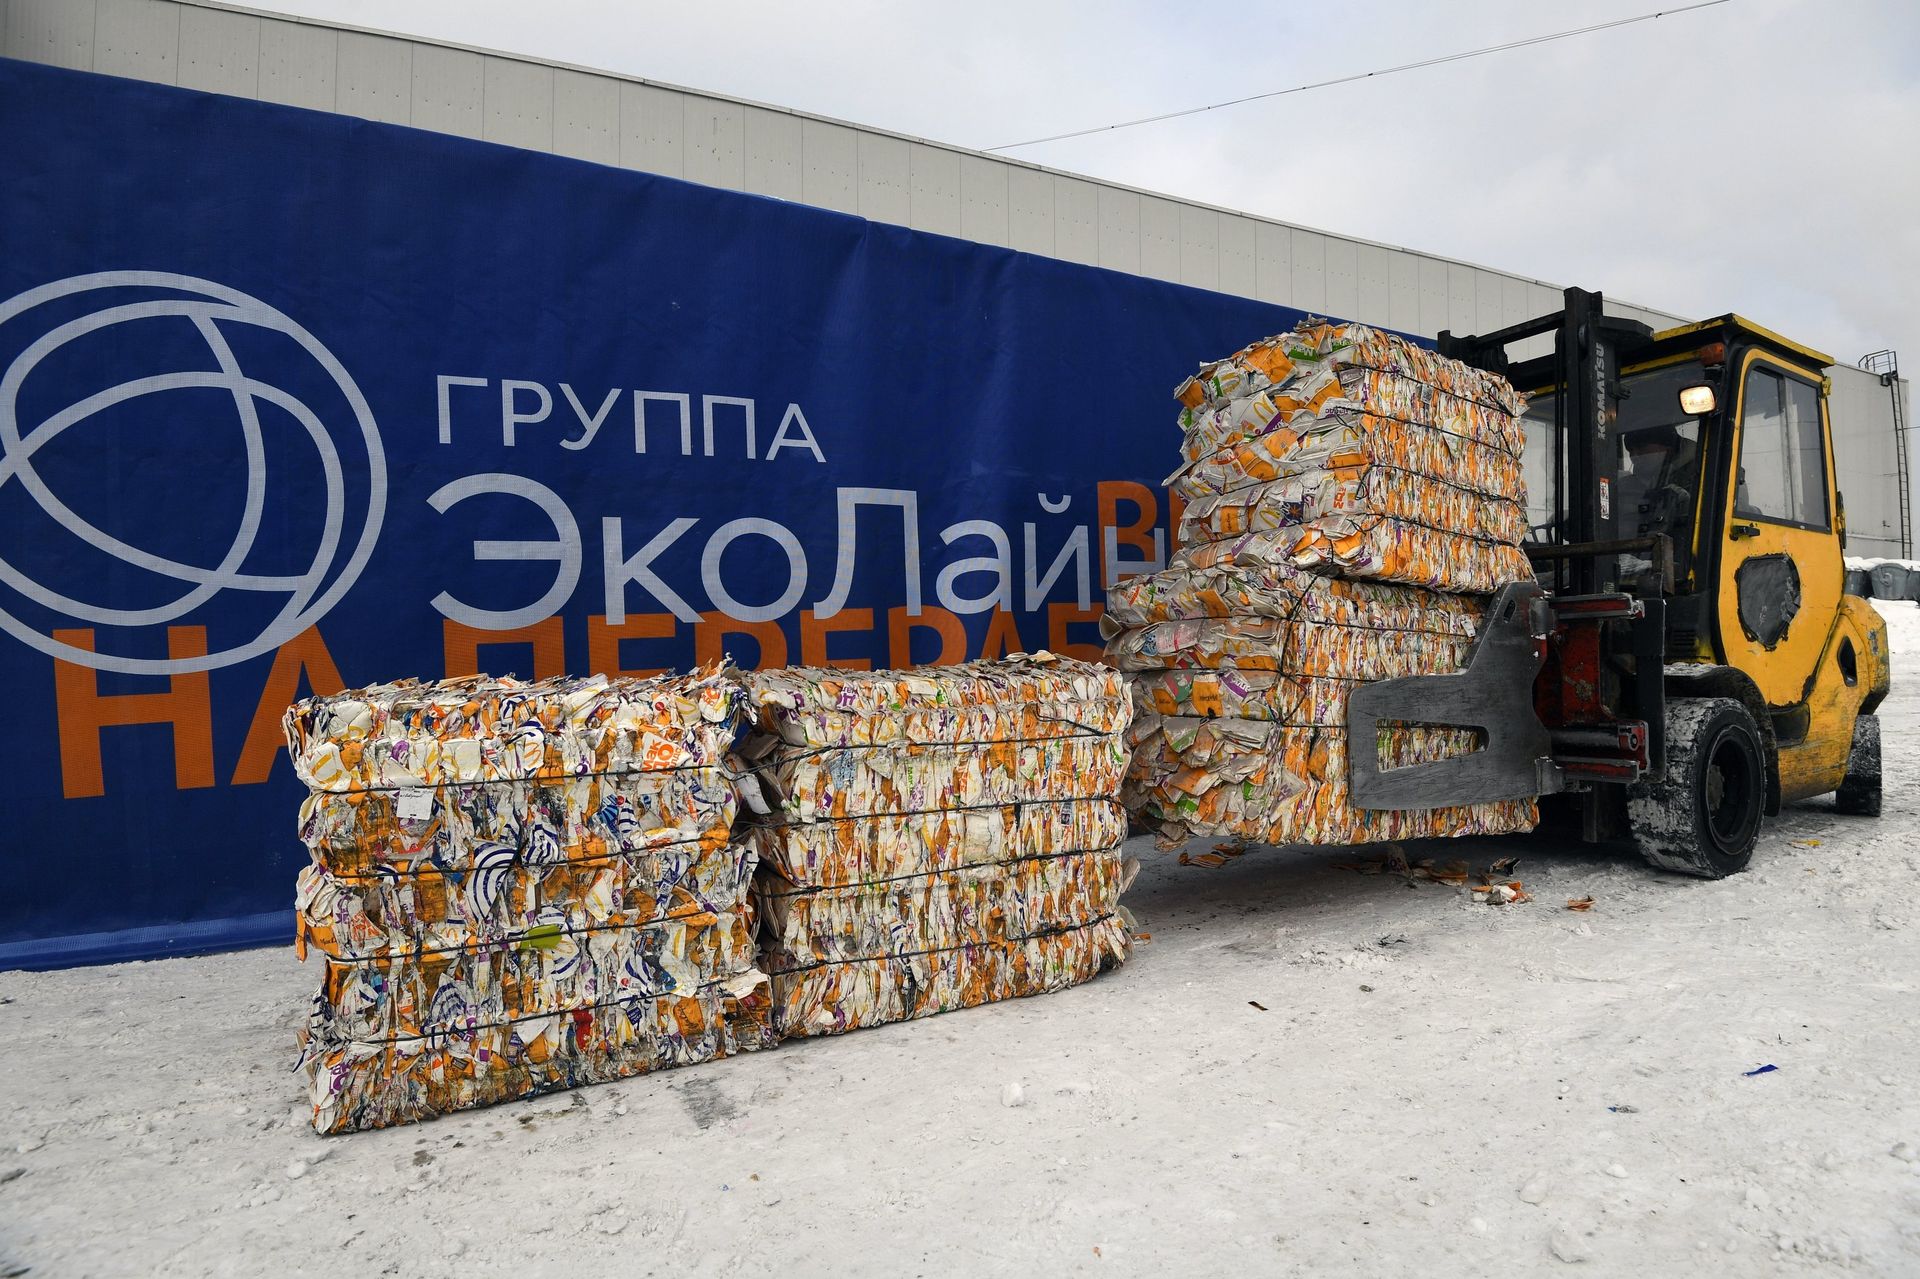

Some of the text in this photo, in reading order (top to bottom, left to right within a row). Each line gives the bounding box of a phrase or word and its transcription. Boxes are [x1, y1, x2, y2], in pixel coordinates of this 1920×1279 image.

[436, 374, 827, 464] ГРУППА
[1594, 341, 1607, 440] KOMATSU
[425, 472, 1166, 630] ЭкоЛайн
